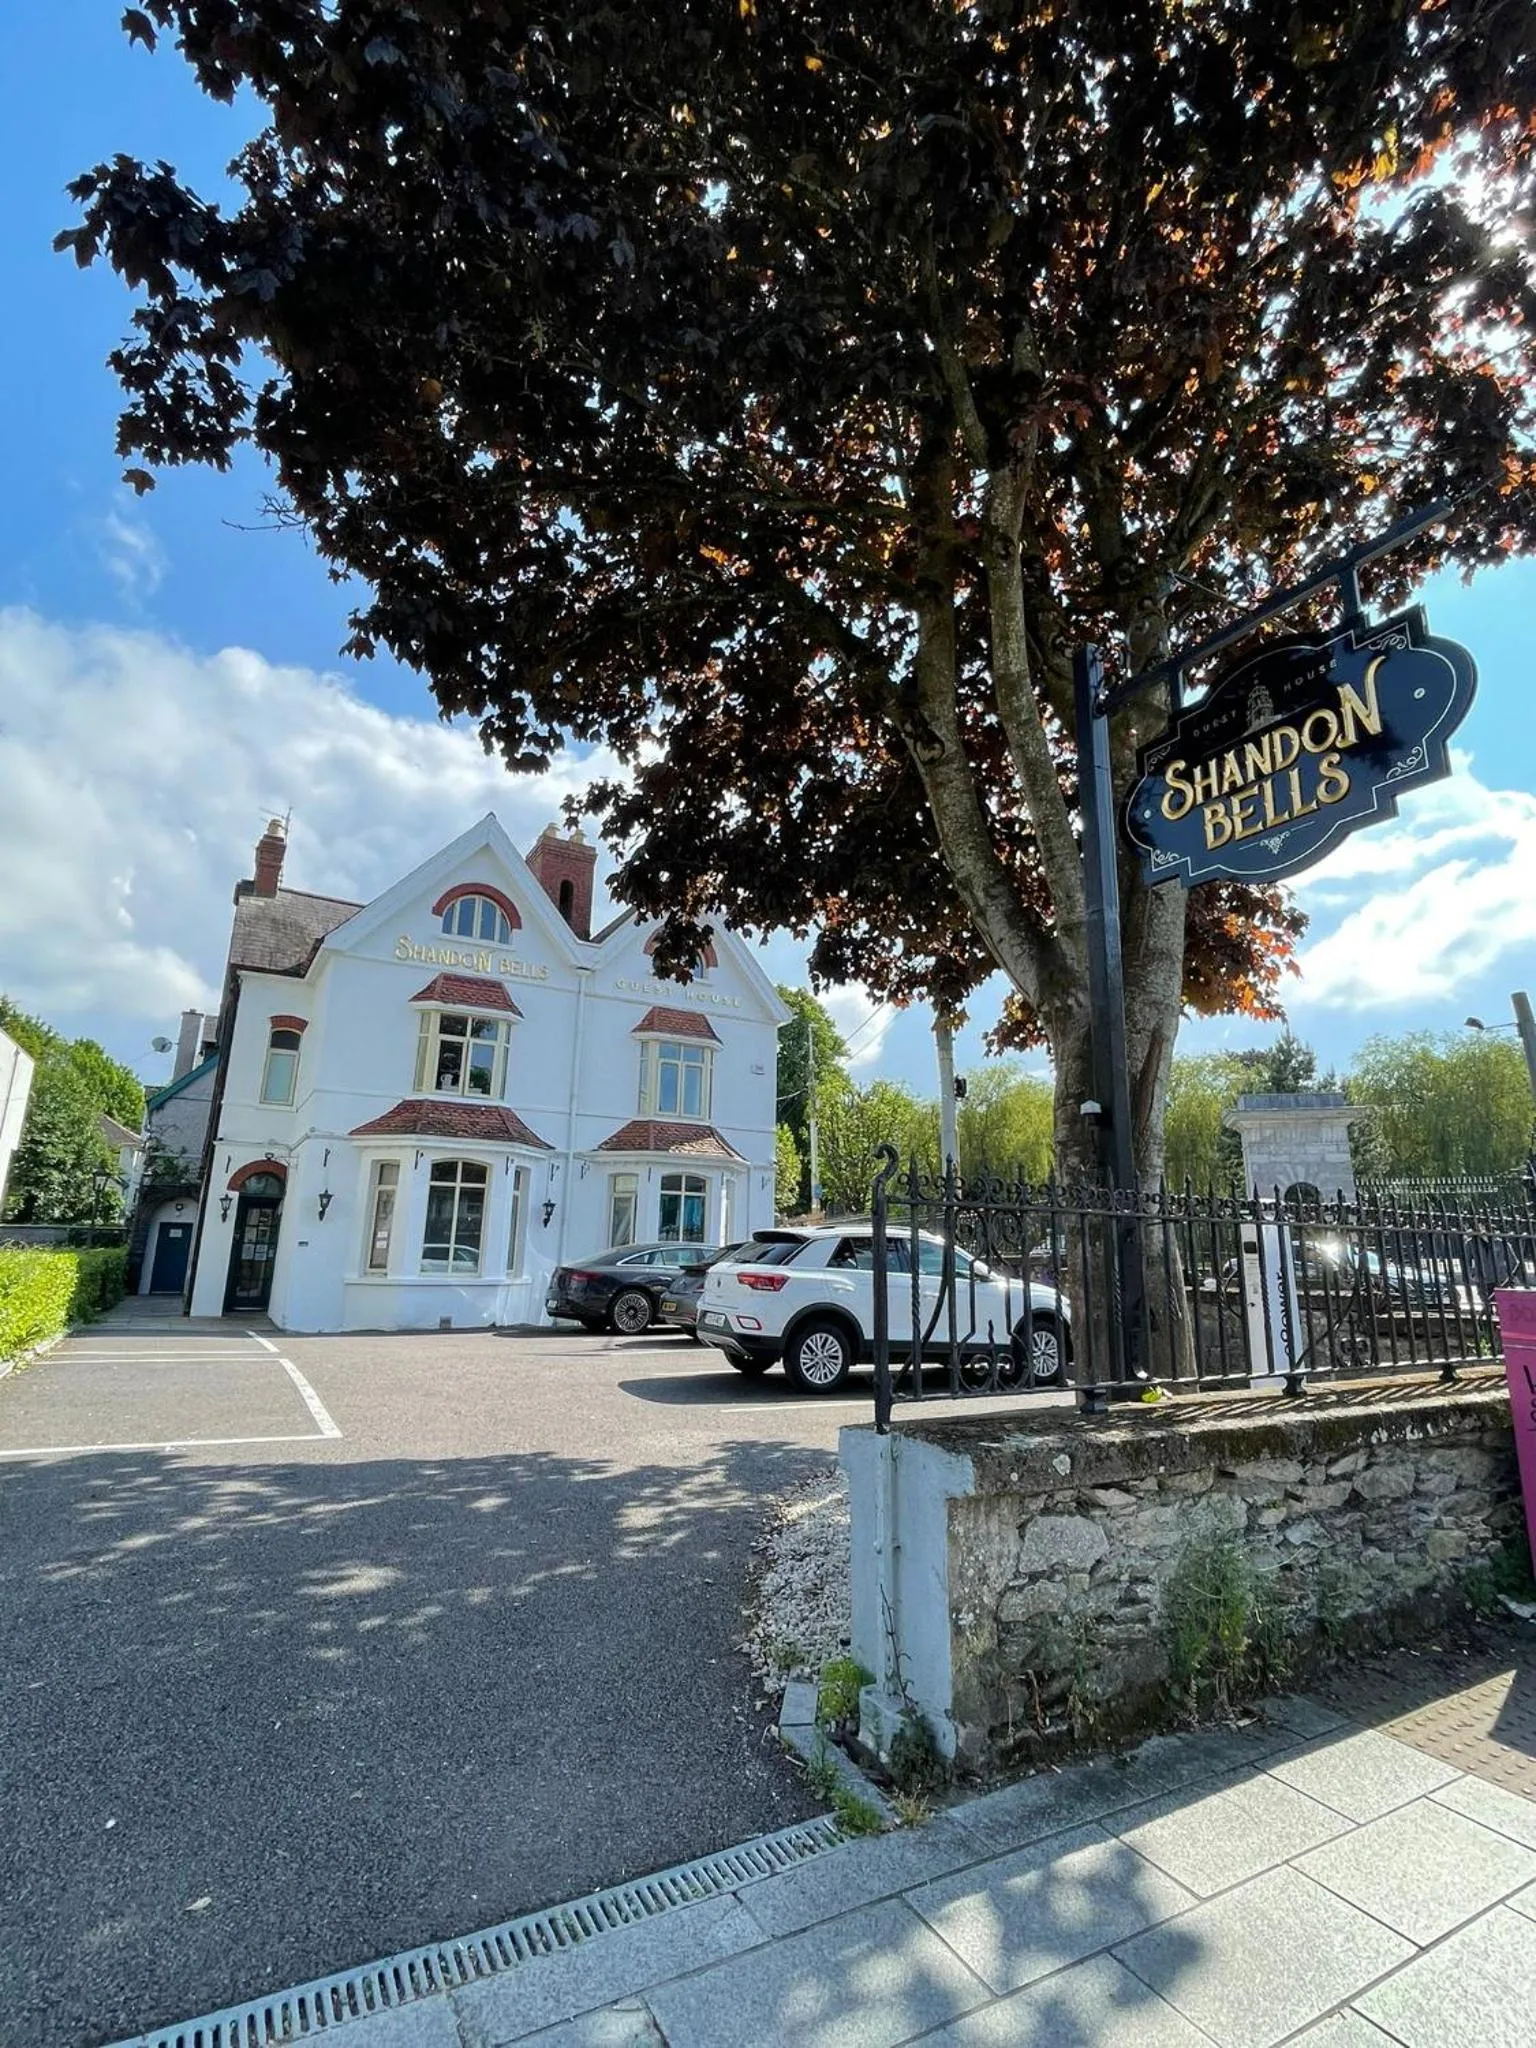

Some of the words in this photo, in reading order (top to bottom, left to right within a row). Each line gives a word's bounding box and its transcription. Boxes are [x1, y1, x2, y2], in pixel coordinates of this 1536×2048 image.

[1161, 655, 1387, 821] SHANDON
[1192, 711, 1237, 738] GUEST
[1283, 658, 1337, 693] HOUSE
[1204, 752, 1350, 850] BELLS
[395, 935, 492, 974] SHANDON
[499, 957, 549, 980] BELLS
[615, 977, 673, 996] GUEST
[685, 989, 742, 1008] HOUSE
